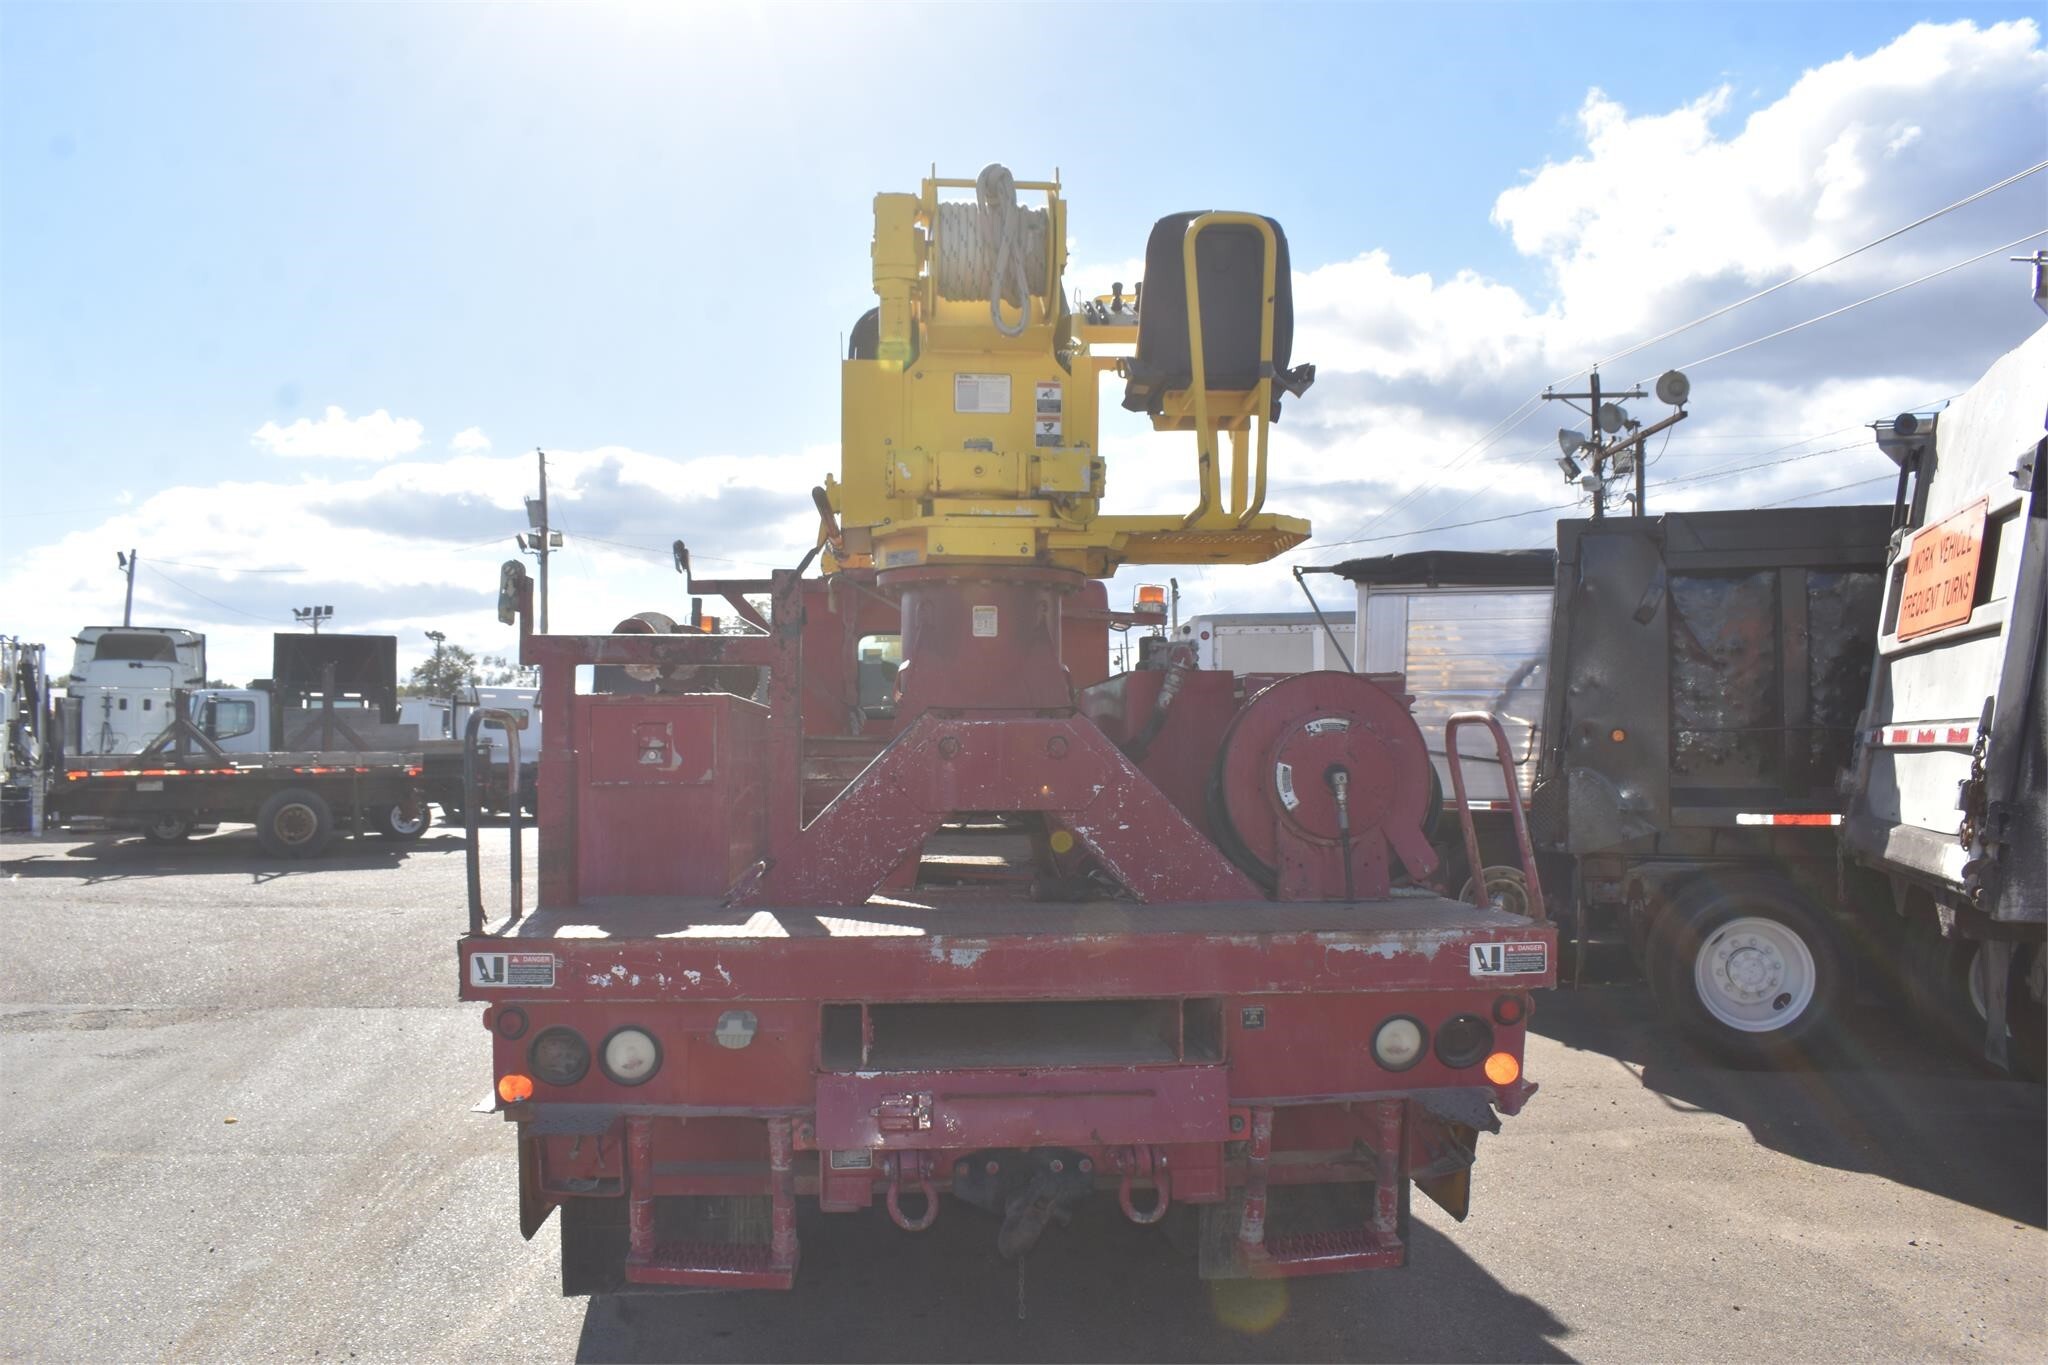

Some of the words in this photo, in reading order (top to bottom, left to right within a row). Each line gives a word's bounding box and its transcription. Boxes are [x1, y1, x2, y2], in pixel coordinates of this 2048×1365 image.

[1913, 544, 1936, 576] WORK
[1940, 524, 1974, 564] VEHICLE
[1903, 583, 1942, 619] FREQUENT
[1942, 571, 1971, 607] TURNS
[522, 955, 550, 963] DANGER
